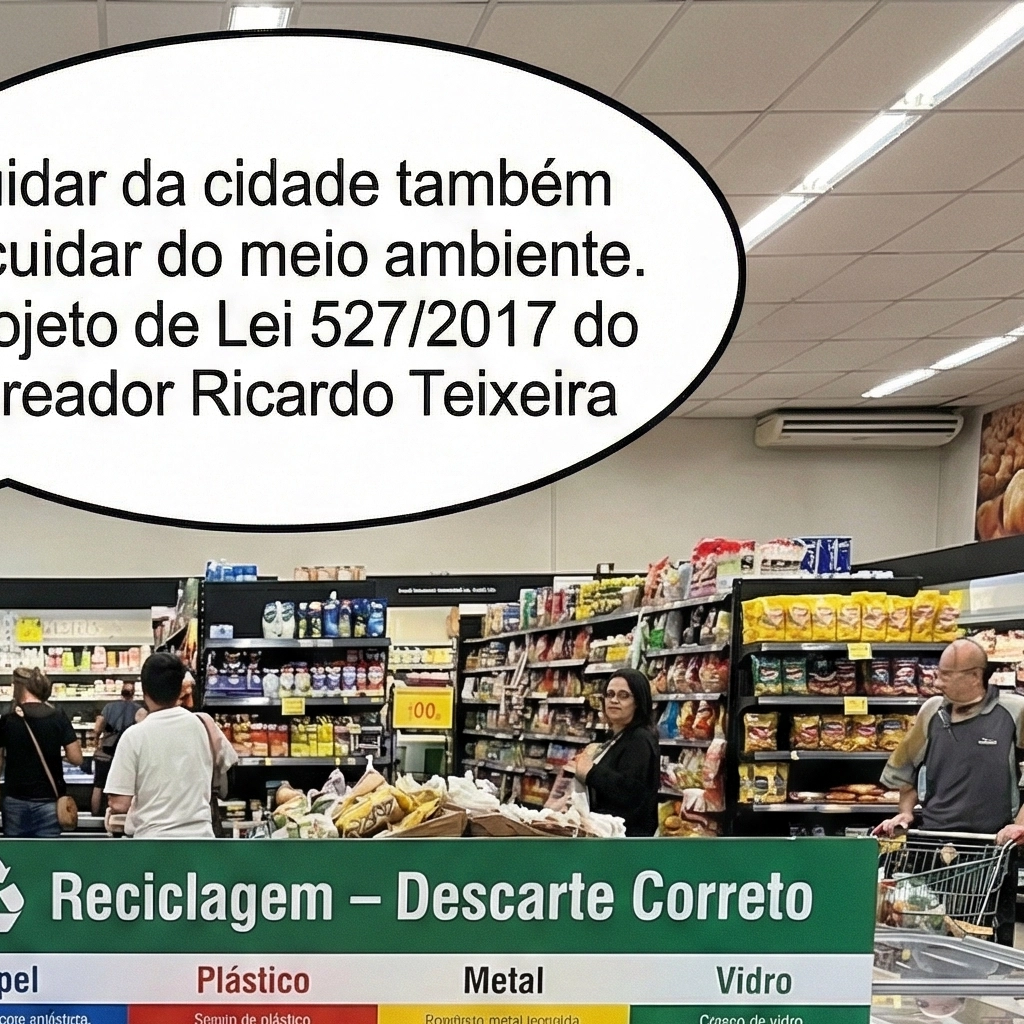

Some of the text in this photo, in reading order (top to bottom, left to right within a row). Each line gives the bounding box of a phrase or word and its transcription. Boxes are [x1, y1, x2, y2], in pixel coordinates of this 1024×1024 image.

[52, 871, 333, 932] Reciclagem
[397, 871, 614, 921] Descarte
[632, 870, 813, 921] Correto
[197, 965, 310, 994] Plástico
[464, 966, 544, 995] Metal
[716, 966, 792, 995] Vidro
